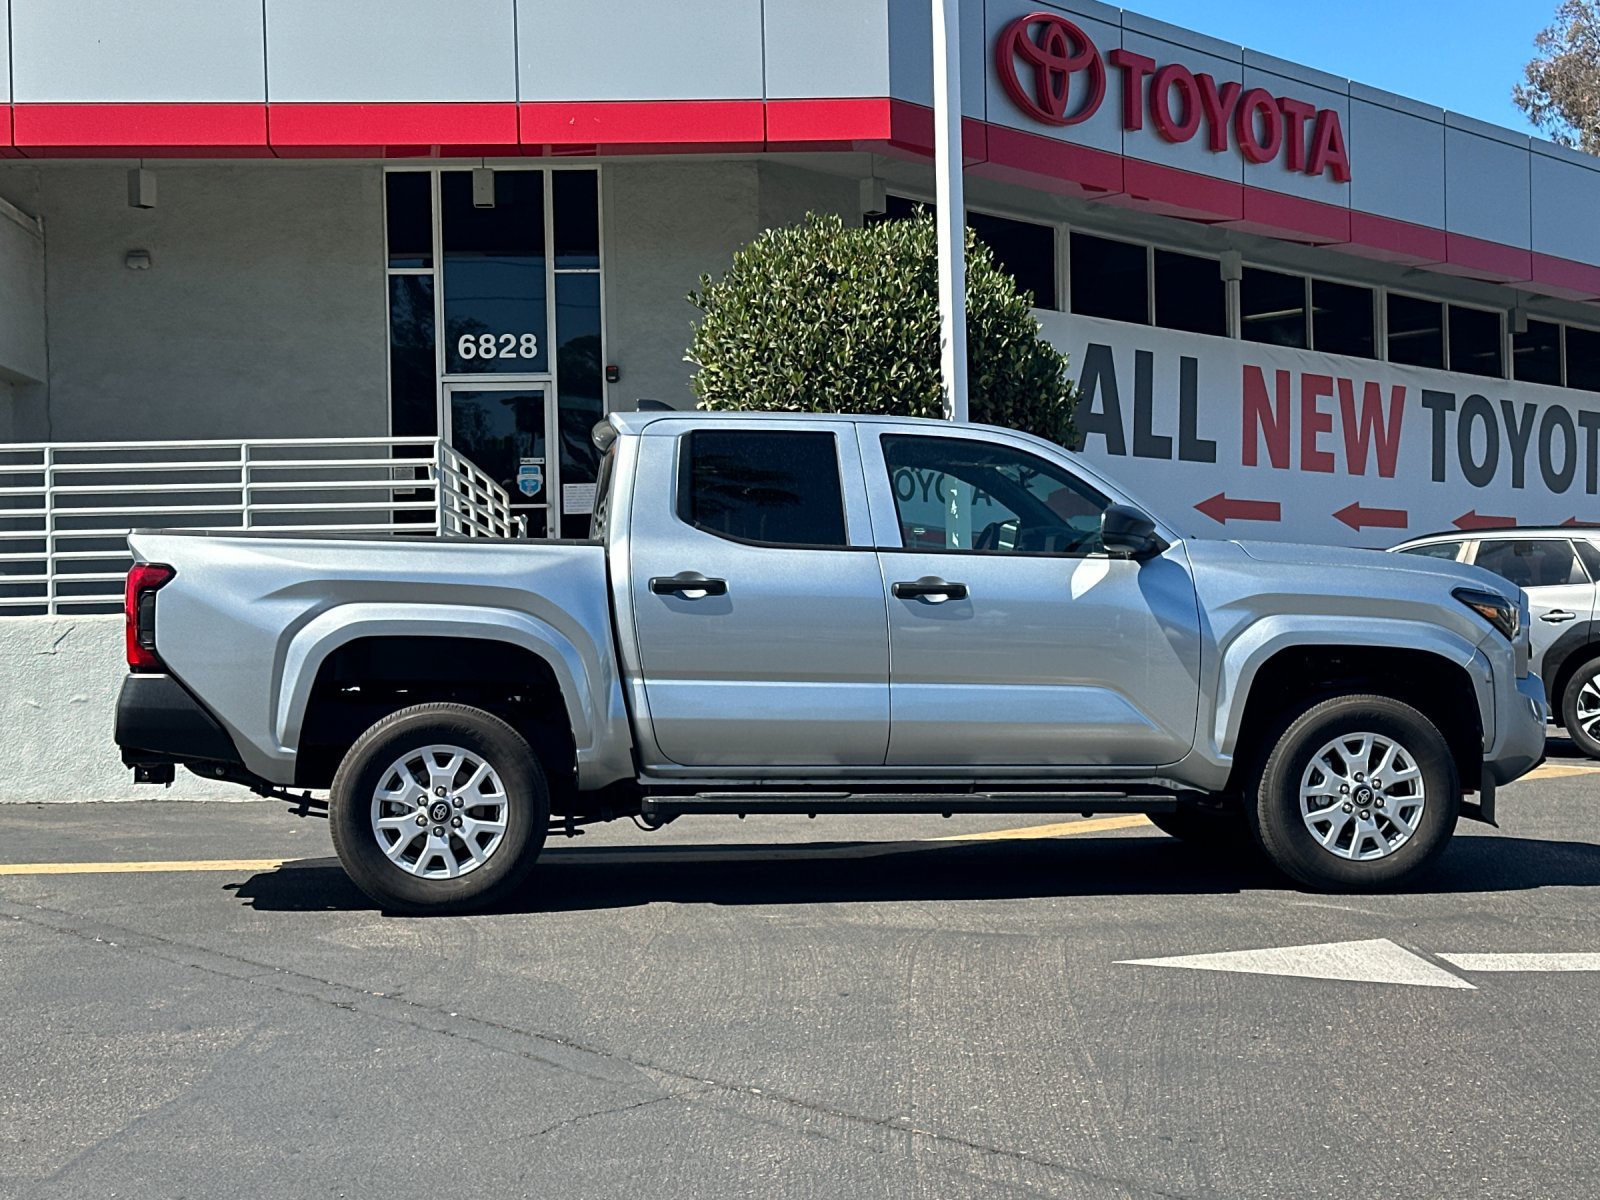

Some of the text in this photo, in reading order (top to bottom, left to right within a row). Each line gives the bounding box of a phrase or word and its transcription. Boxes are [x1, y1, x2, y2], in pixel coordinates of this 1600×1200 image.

[1109, 48, 1352, 183] TOYOTA
[457, 333, 538, 360] 6828
[1076, 342, 1600, 495] ALL NEW TOYOT
